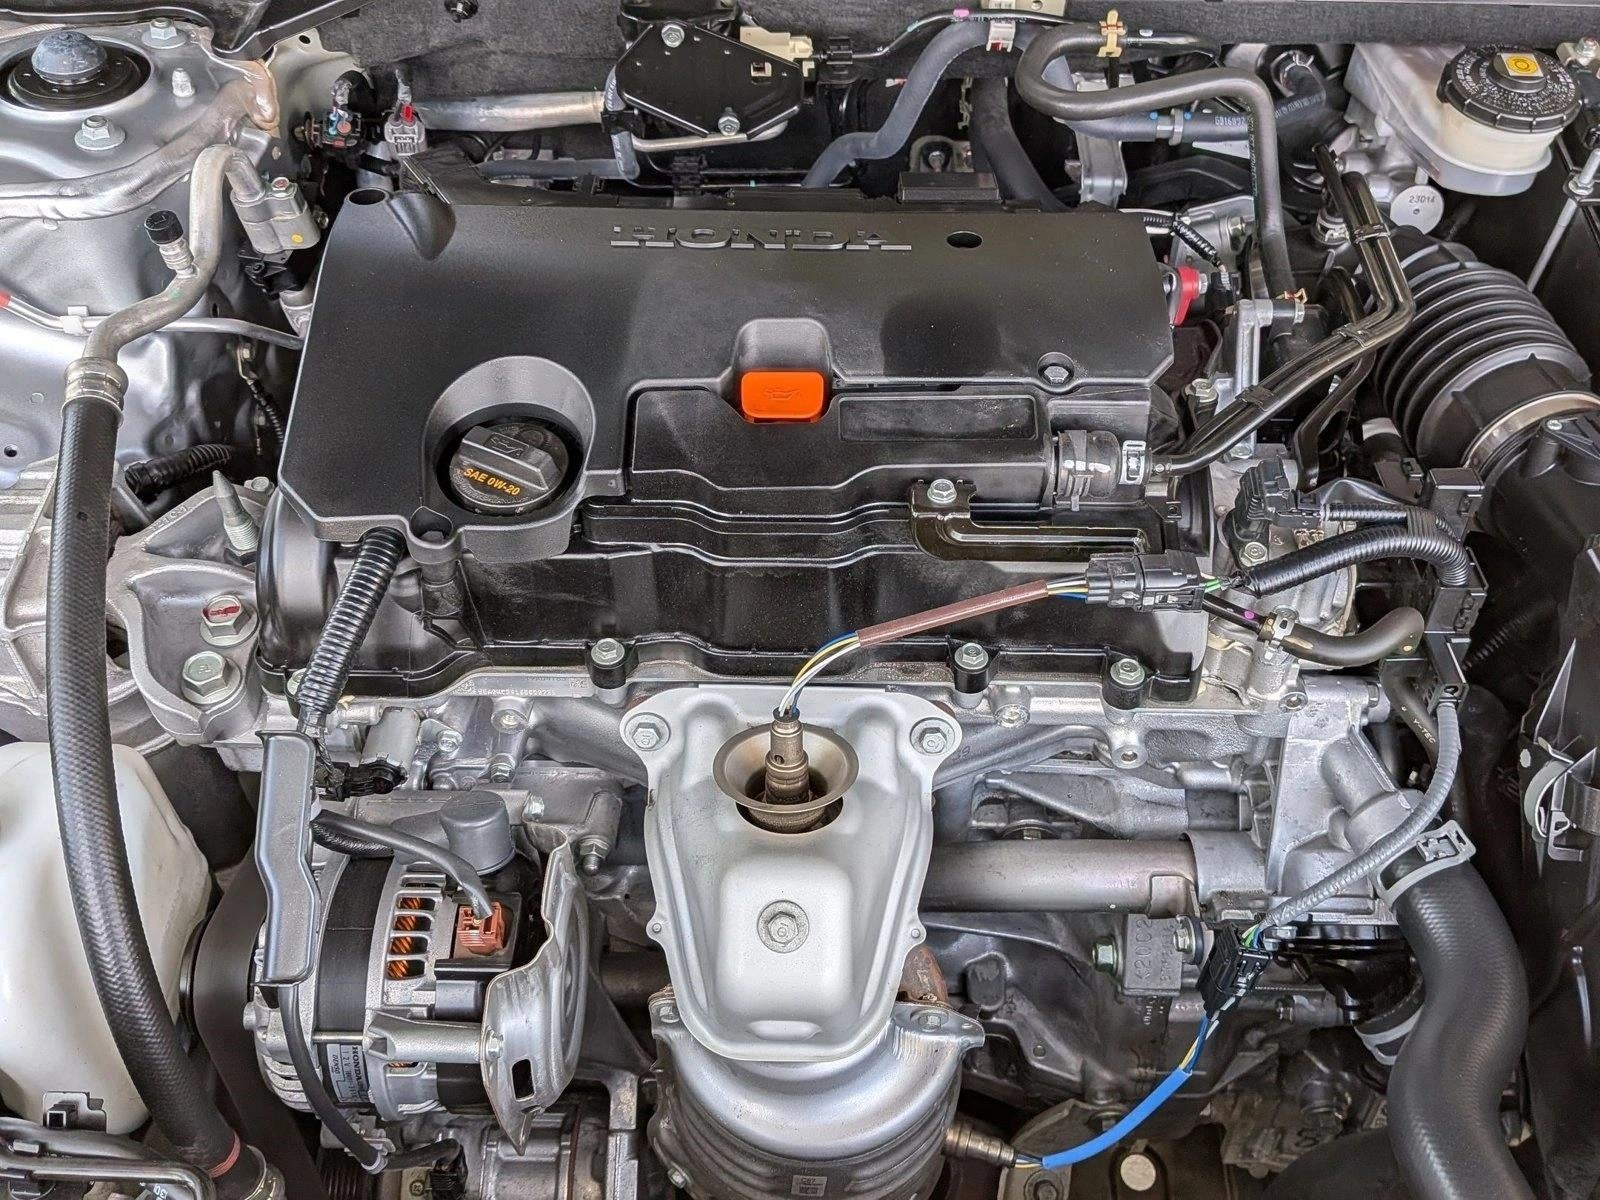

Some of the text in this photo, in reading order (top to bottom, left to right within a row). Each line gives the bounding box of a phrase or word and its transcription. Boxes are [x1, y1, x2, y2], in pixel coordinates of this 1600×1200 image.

[610, 226, 912, 251] HONDA
[463, 467, 489, 483] SAE
[486, 476, 522, 496] 0W-20
[352, 1046, 362, 1082] HONDA
